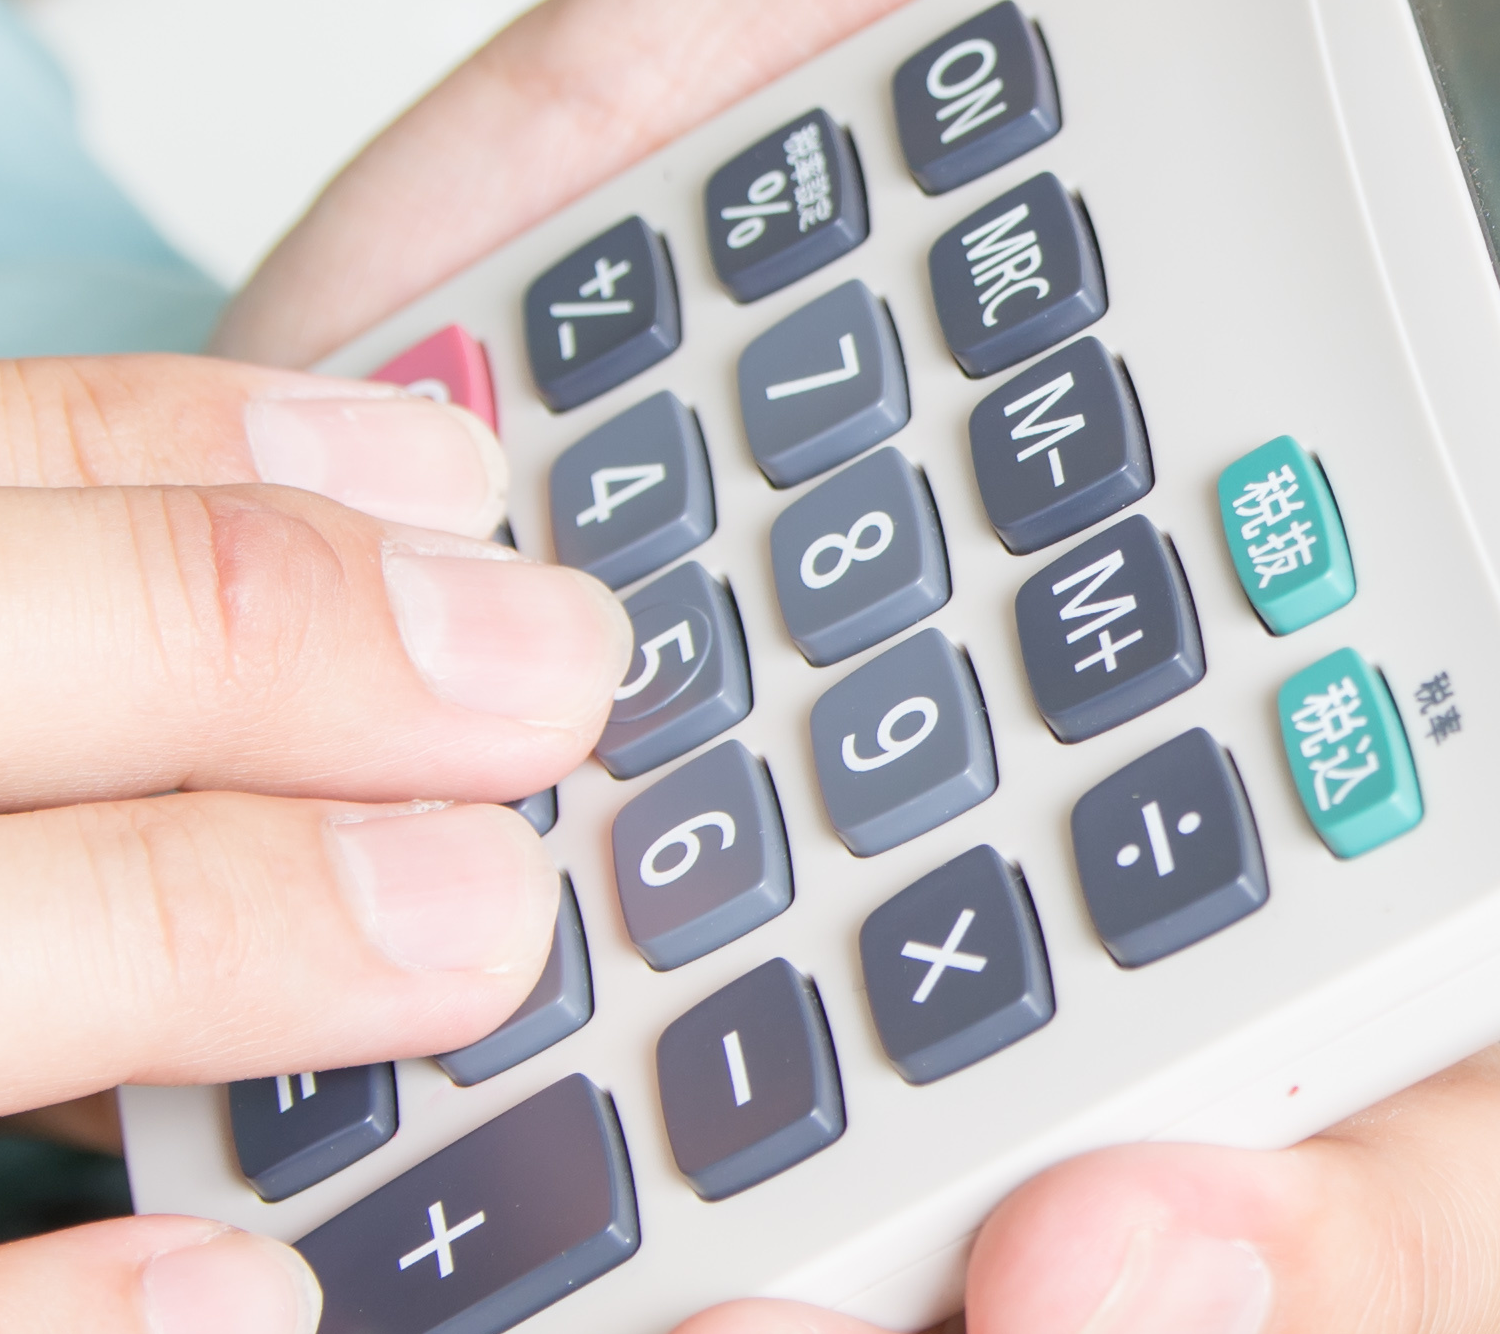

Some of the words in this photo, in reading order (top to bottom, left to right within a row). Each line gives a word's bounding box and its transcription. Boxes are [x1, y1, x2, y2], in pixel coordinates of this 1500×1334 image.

[925, 37, 1007, 143] ON
[720, 169, 792, 249] %
[961, 203, 1050, 327] MRC
[765, 333, 860, 400] 7
[1003, 371, 1086, 487] M-
[576, 463, 666, 527] 4
[1232, 464, 1318, 589] 税抜
[800, 510, 894, 589] 8
[1051, 549, 1144, 673] M+
[614, 620, 695, 701] 5
[841, 696, 939, 772] 9
[1291, 676, 1387, 811] 税込
[1413, 670, 1462, 746] 税率
[639, 811, 736, 887] 6
[1116, 801, 1201, 876] ÷
[398, 1201, 486, 1278] +
